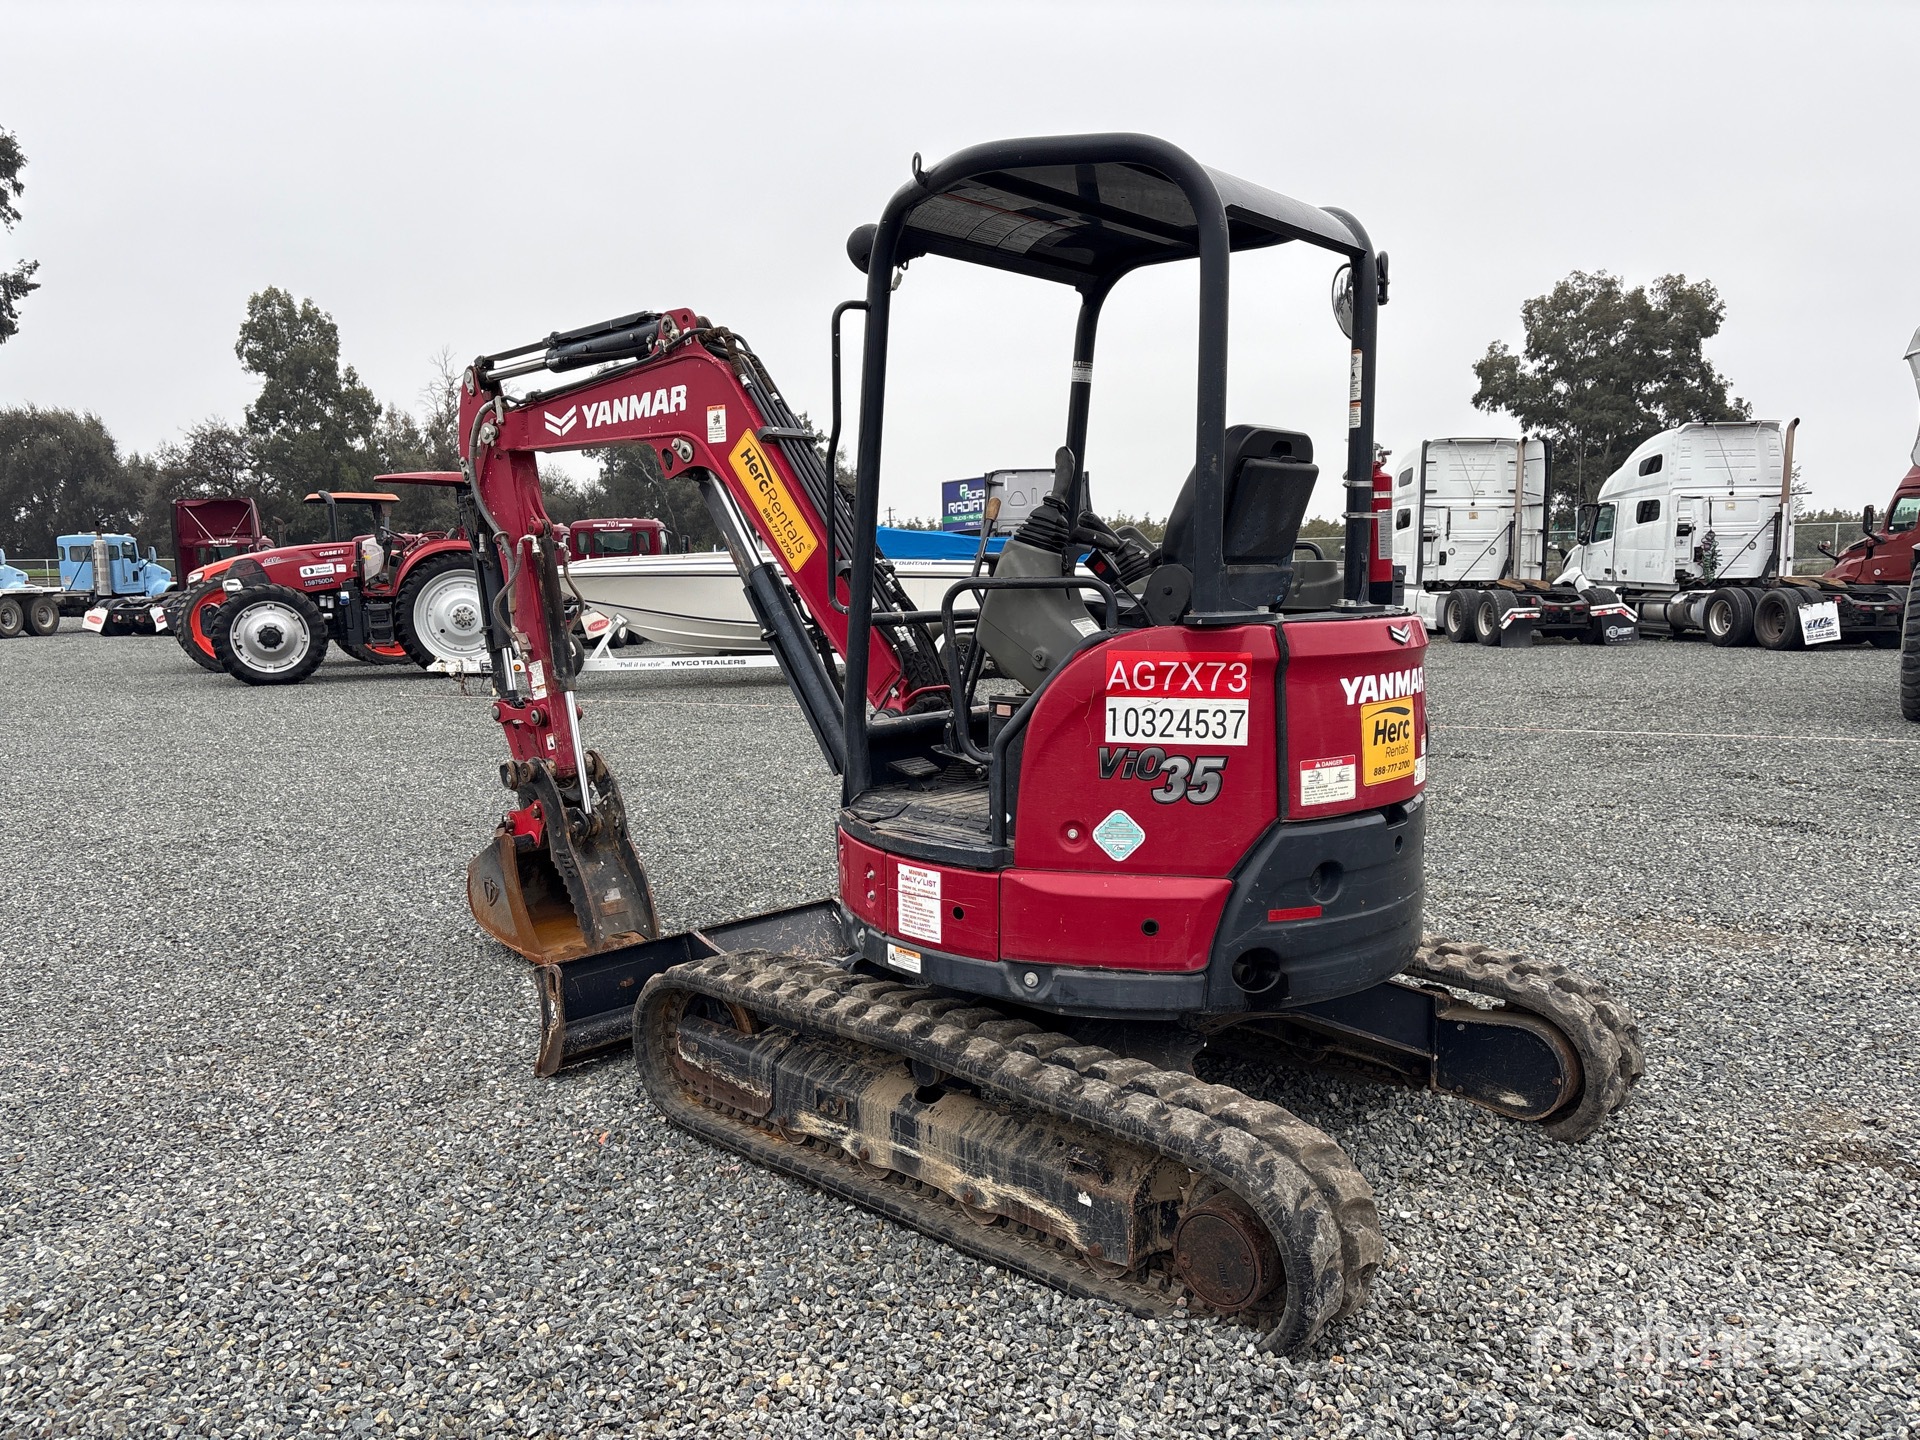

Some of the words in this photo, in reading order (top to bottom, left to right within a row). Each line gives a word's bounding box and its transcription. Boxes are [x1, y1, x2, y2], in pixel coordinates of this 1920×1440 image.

[581, 384, 687, 429] YANMAR
[762, 508, 795, 560] 888-777-2700
[1106, 660, 1247, 693] AG7X73
[1340, 666, 1424, 706] YANMAR
[1108, 707, 1246, 740] 10324537
[1373, 719, 1410, 746] Herc
[1321, 759, 1343, 768] DANGER
[1385, 743, 1409, 758] Rentals
[1373, 760, 1411, 776] 888-777-2700
[901, 874, 917, 883] DAILY
[923, 879, 937, 888] LIST
